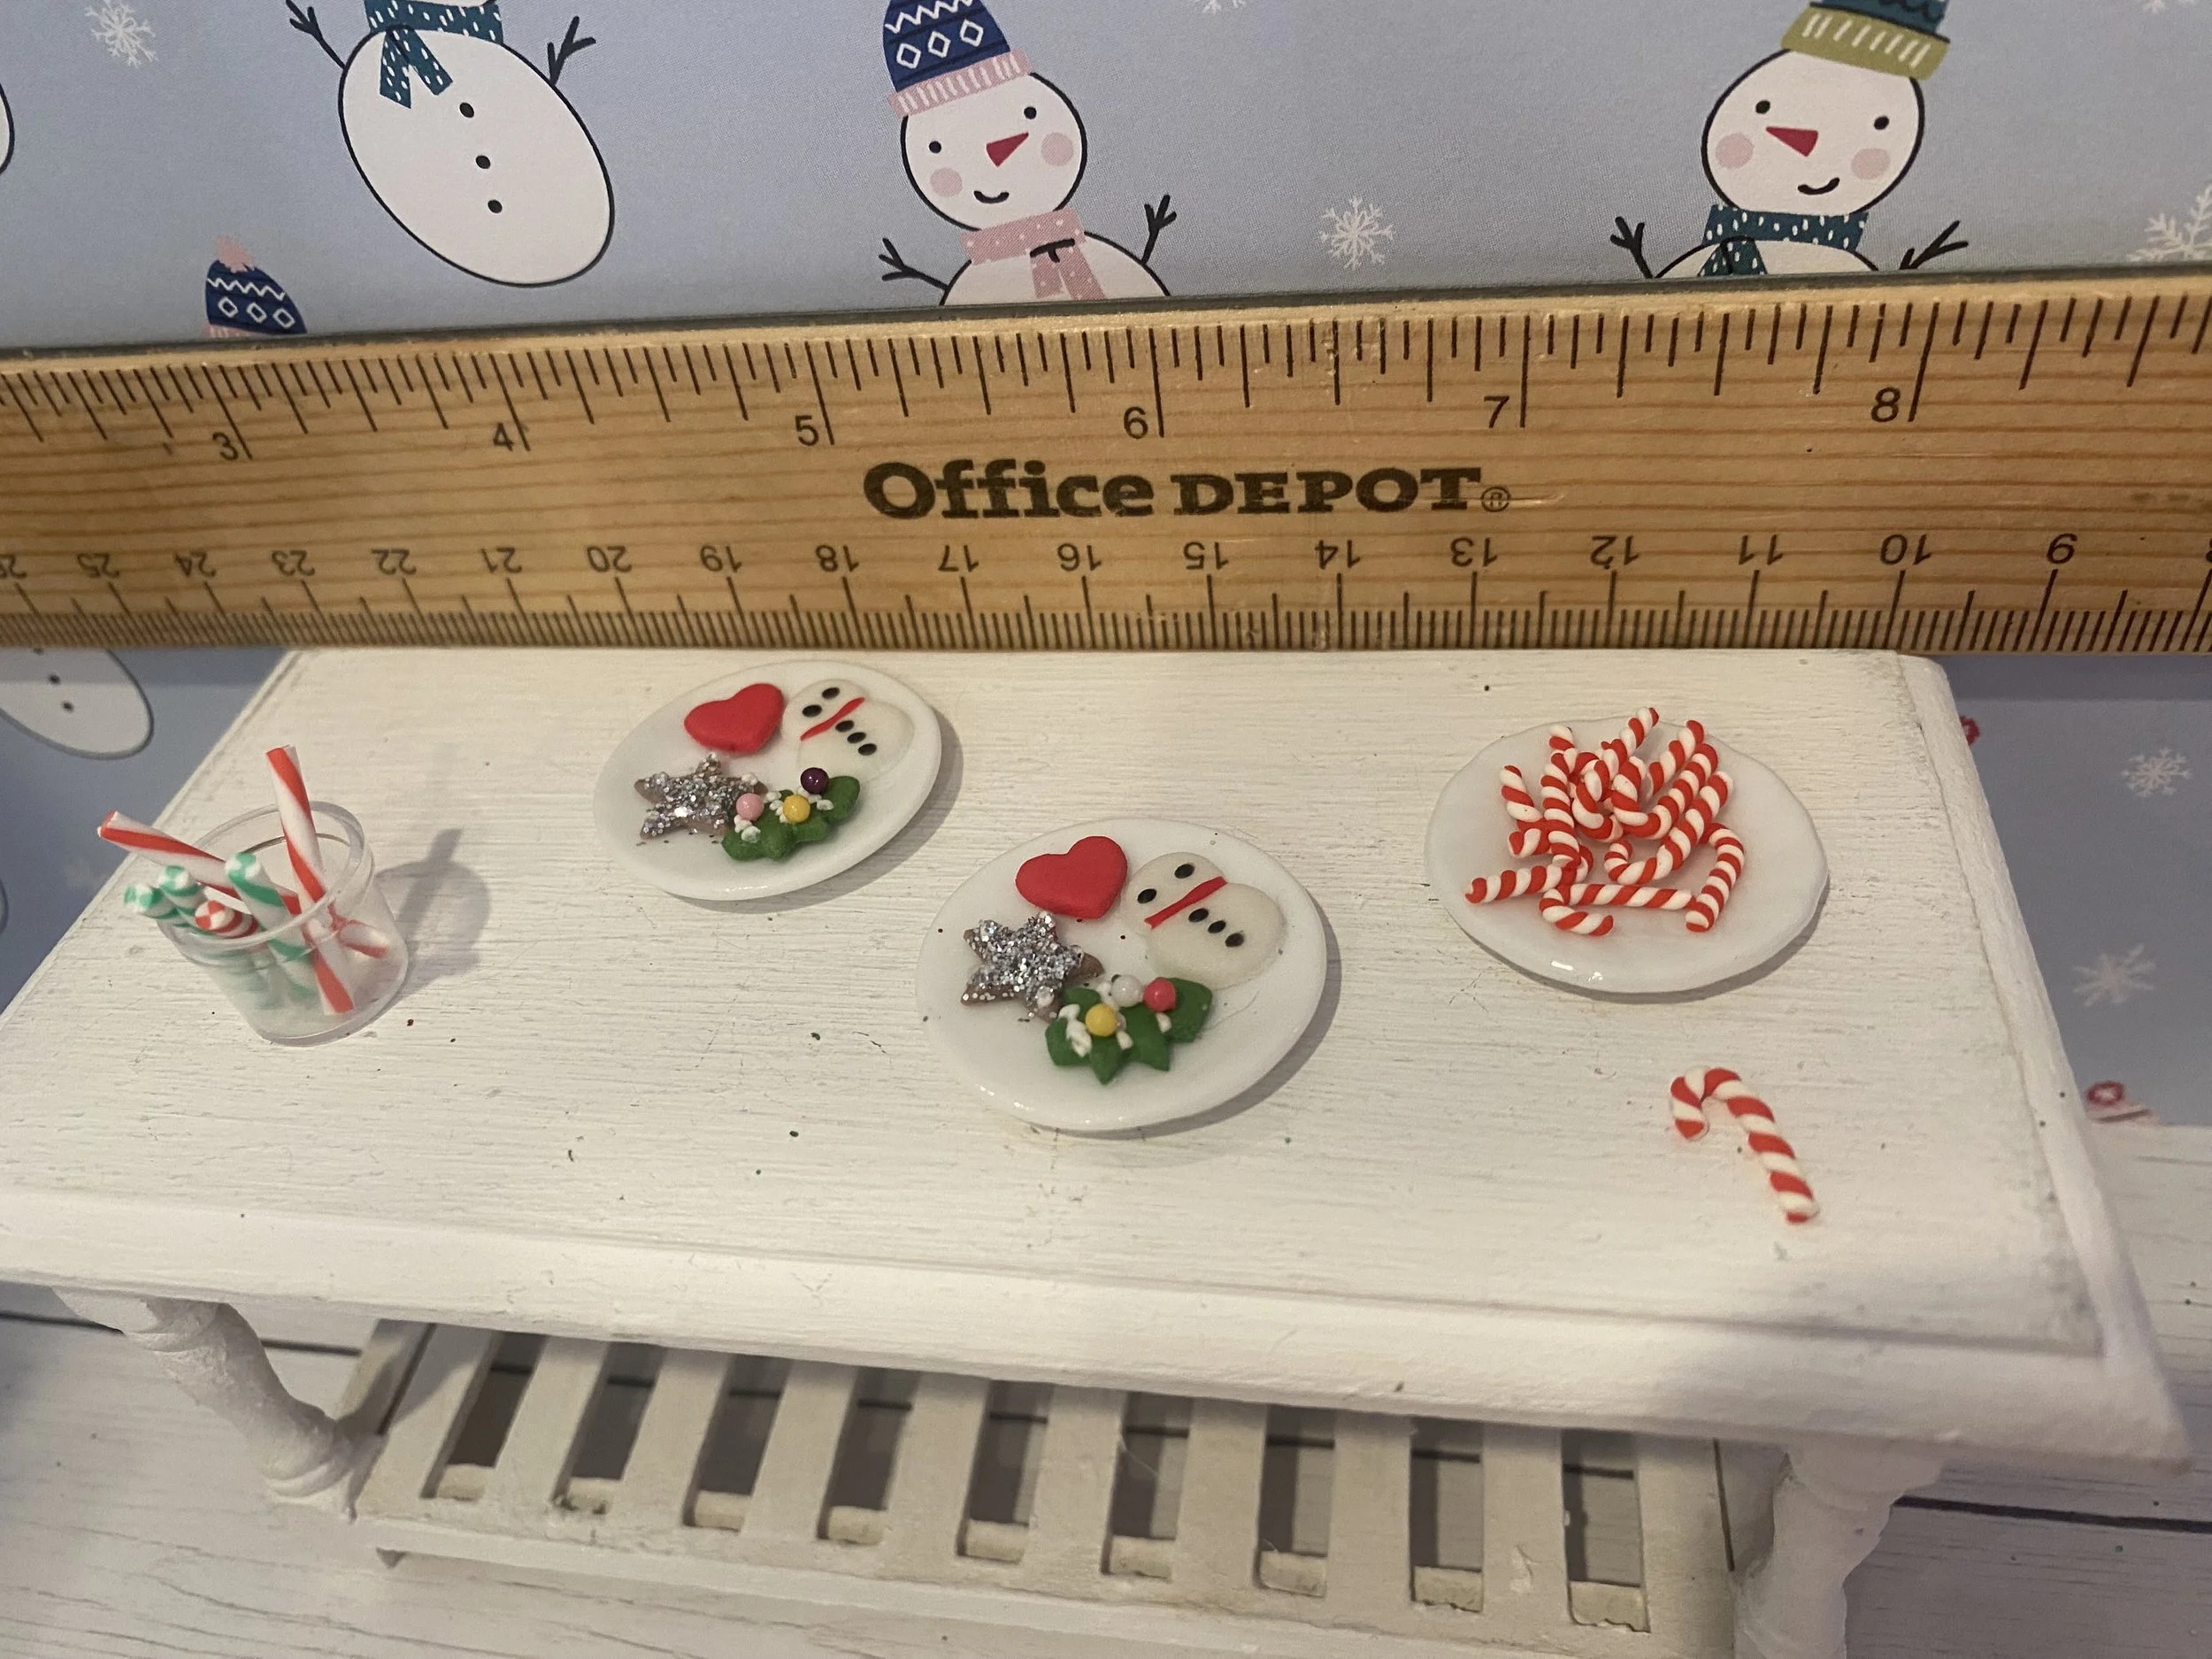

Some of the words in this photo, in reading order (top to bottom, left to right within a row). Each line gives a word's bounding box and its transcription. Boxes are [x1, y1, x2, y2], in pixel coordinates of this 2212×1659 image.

[212, 432, 240, 461] 3
[492, 422, 516, 452] 4
[795, 414, 820, 446] 5
[1123, 405, 1148, 439] 6
[1483, 395, 1510, 429] 7
[1870, 387, 1901, 422] 8
[863, 458, 1155, 519] Office
[271, 549, 316, 577] 23
[371, 548, 418, 576] 22
[480, 546, 523, 574] 21
[586, 544, 634, 573] 20
[699, 544, 743, 573] 19
[815, 544, 860, 572] 18
[937, 544, 979, 572] 17
[1056, 541, 1102, 572] 16
[1182, 541, 1230, 571] 15
[1314, 539, 1362, 571] 14
[1449, 537, 1499, 568] 13
[1590, 534, 1640, 569] 12
[1738, 534, 1784, 565] 11
[1879, 533, 1933, 565] 10
[77, 552, 120, 578] 25
[175, 550, 217, 578] 24
